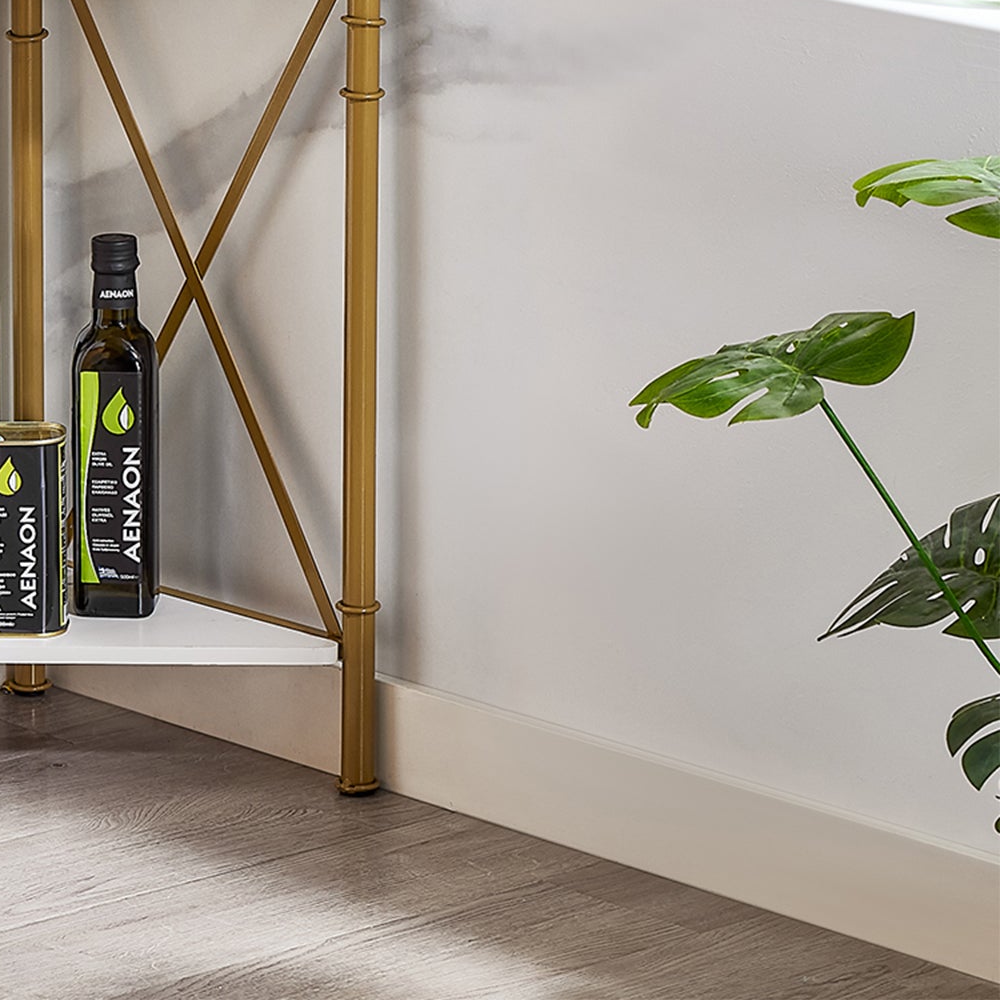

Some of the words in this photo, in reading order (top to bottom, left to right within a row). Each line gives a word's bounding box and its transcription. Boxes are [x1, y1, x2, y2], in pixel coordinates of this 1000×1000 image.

[100, 289, 134, 298] AENAON
[122, 447, 140, 563] AENAON
[19, 506, 36, 610] AENAON
